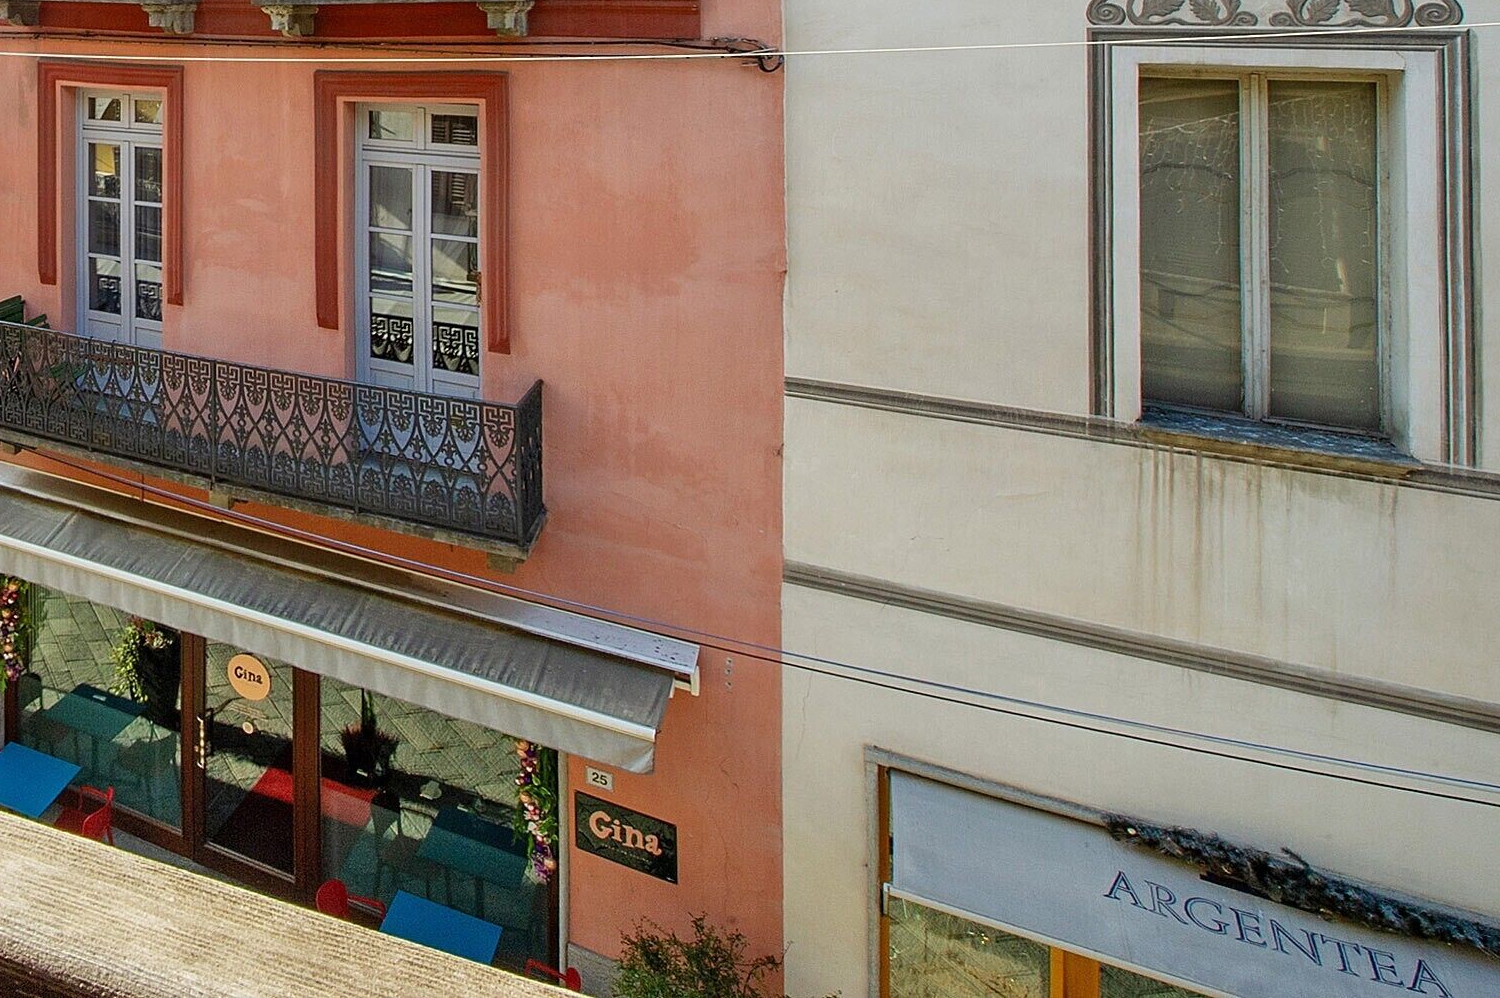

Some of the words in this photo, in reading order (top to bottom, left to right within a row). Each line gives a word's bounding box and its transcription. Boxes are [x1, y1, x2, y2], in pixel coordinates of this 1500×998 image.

[234, 665, 263, 684] Gina
[591, 771, 608, 786] 25
[588, 810, 662, 856] Gina
[1103, 870, 1454, 998] ARGENTEA
